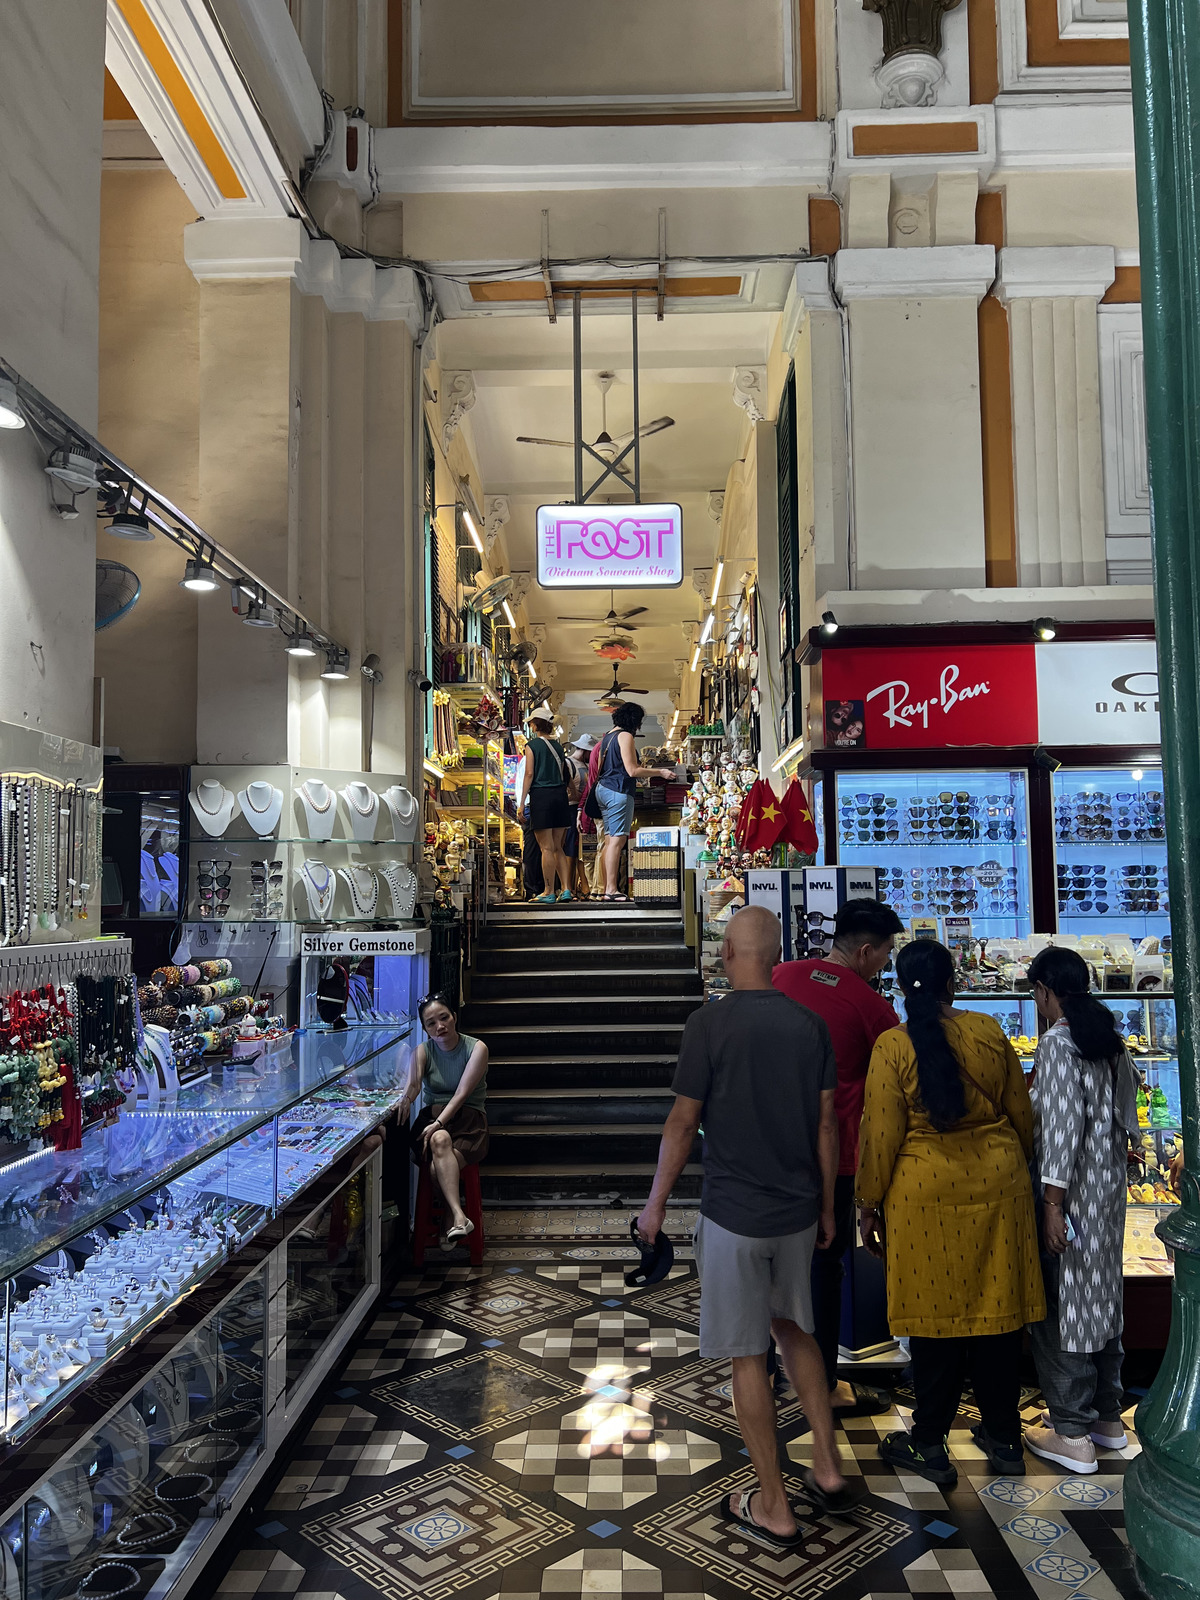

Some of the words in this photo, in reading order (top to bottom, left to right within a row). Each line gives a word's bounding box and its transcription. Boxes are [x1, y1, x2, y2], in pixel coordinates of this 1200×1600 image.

[545, 524, 555, 558] THE
[556, 518, 674, 560] POST
[545, 566, 594, 577] Vietnam
[596, 566, 644, 577] Souvenir
[646, 565, 674, 577] Shop
[303, 937, 344, 952] Silver
[348, 937, 415, 952] Gemstone
[816, 971, 838, 981] VIETNAM
